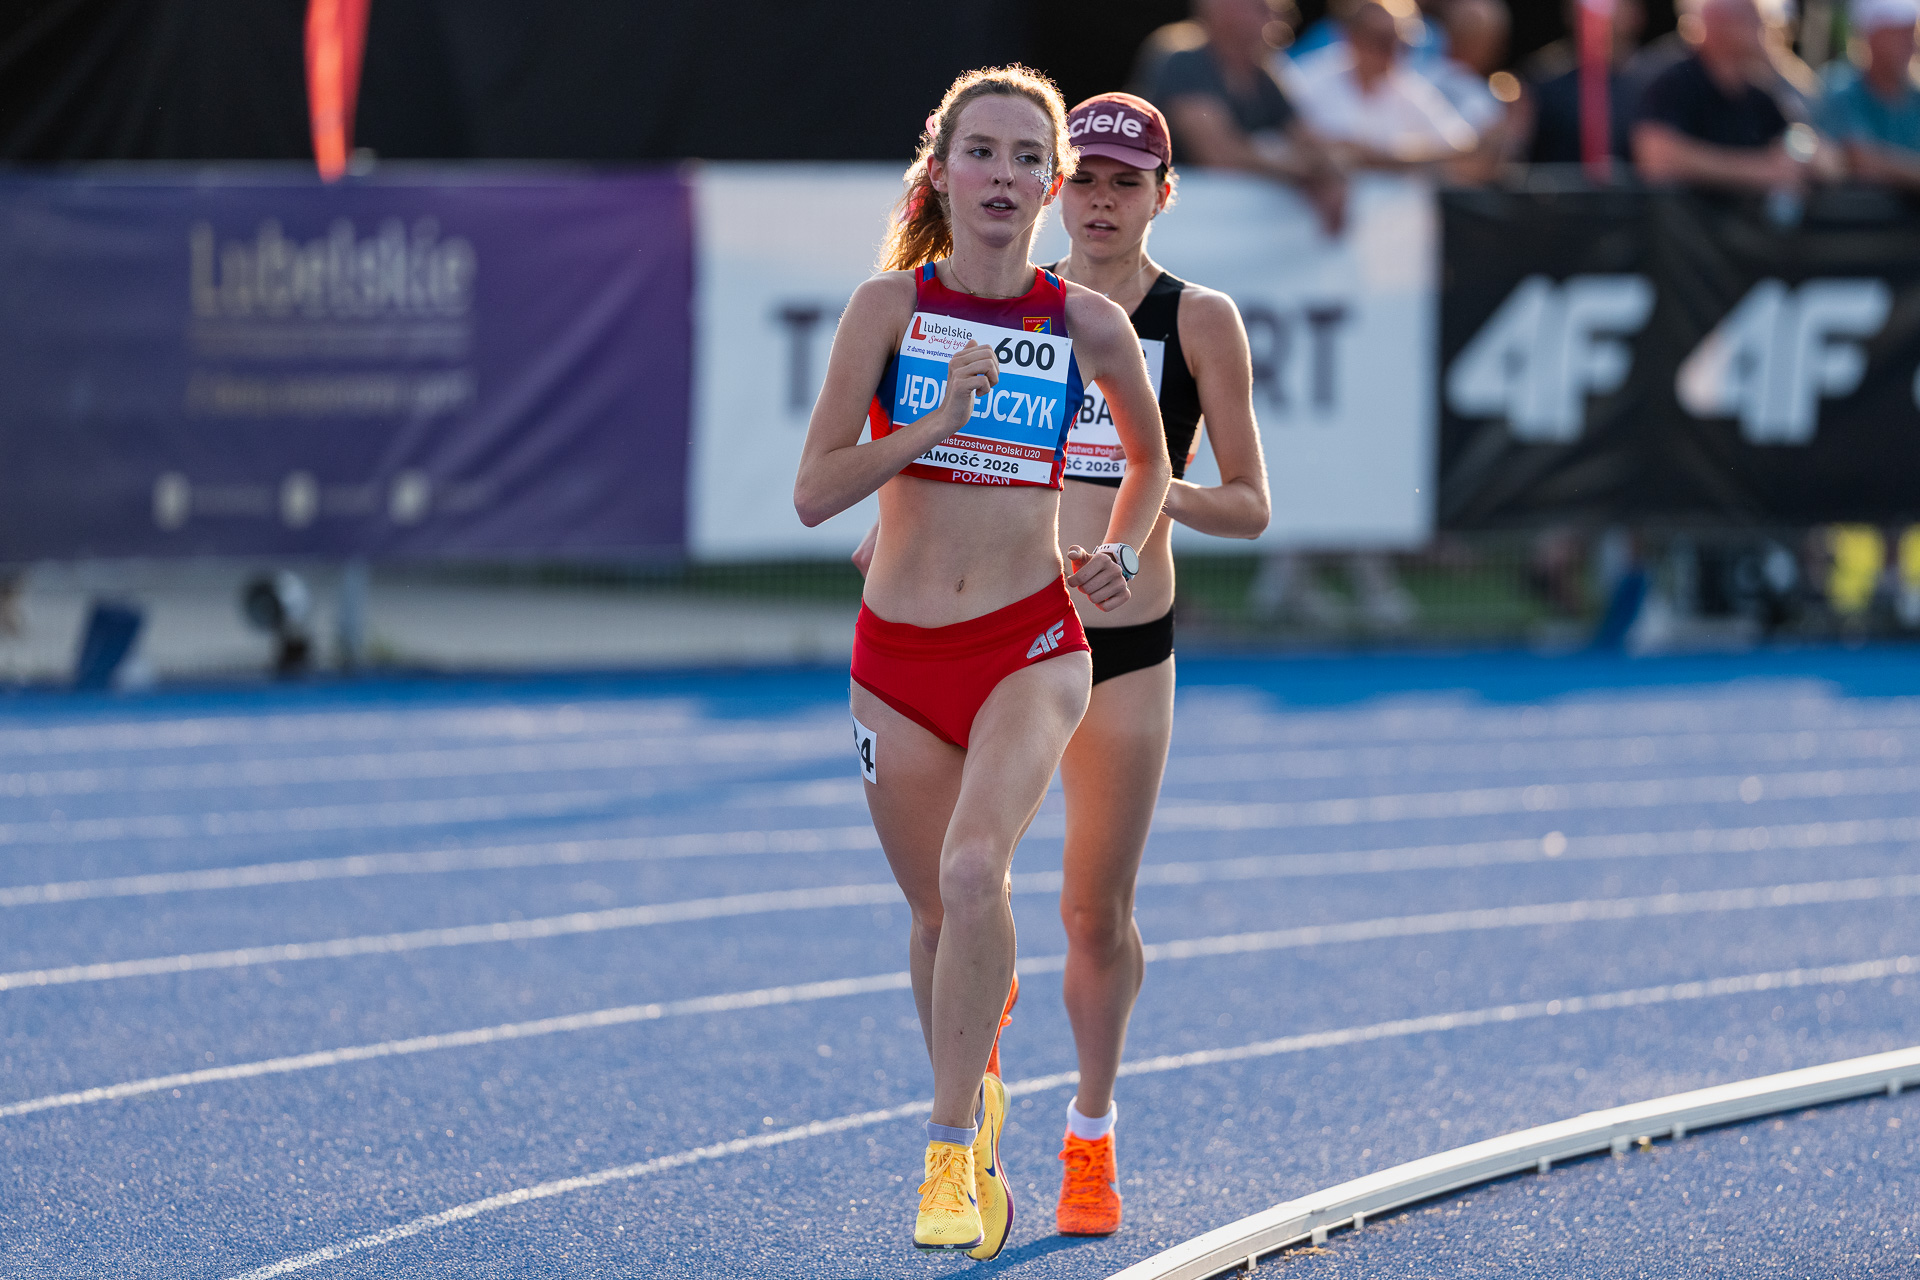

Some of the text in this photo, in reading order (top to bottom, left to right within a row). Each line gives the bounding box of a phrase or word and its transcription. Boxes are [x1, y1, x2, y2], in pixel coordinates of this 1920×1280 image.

[1069, 110, 1142, 138] ciele
[926, 349, 954, 358] wspieram
[952, 340, 967, 350] życi
[995, 337, 1055, 371] 600
[1448, 277, 1655, 441] 4F
[1678, 280, 1891, 443] 4F
[899, 373, 1058, 430] JĘDEJCZYK
[919, 450, 1019, 474] AMOŚĆ 2026
[995, 444, 1023, 456] Polski
[1024, 450, 1041, 459] U20
[1086, 461, 1120, 472] 2026
[1026, 619, 1064, 659] 4F
